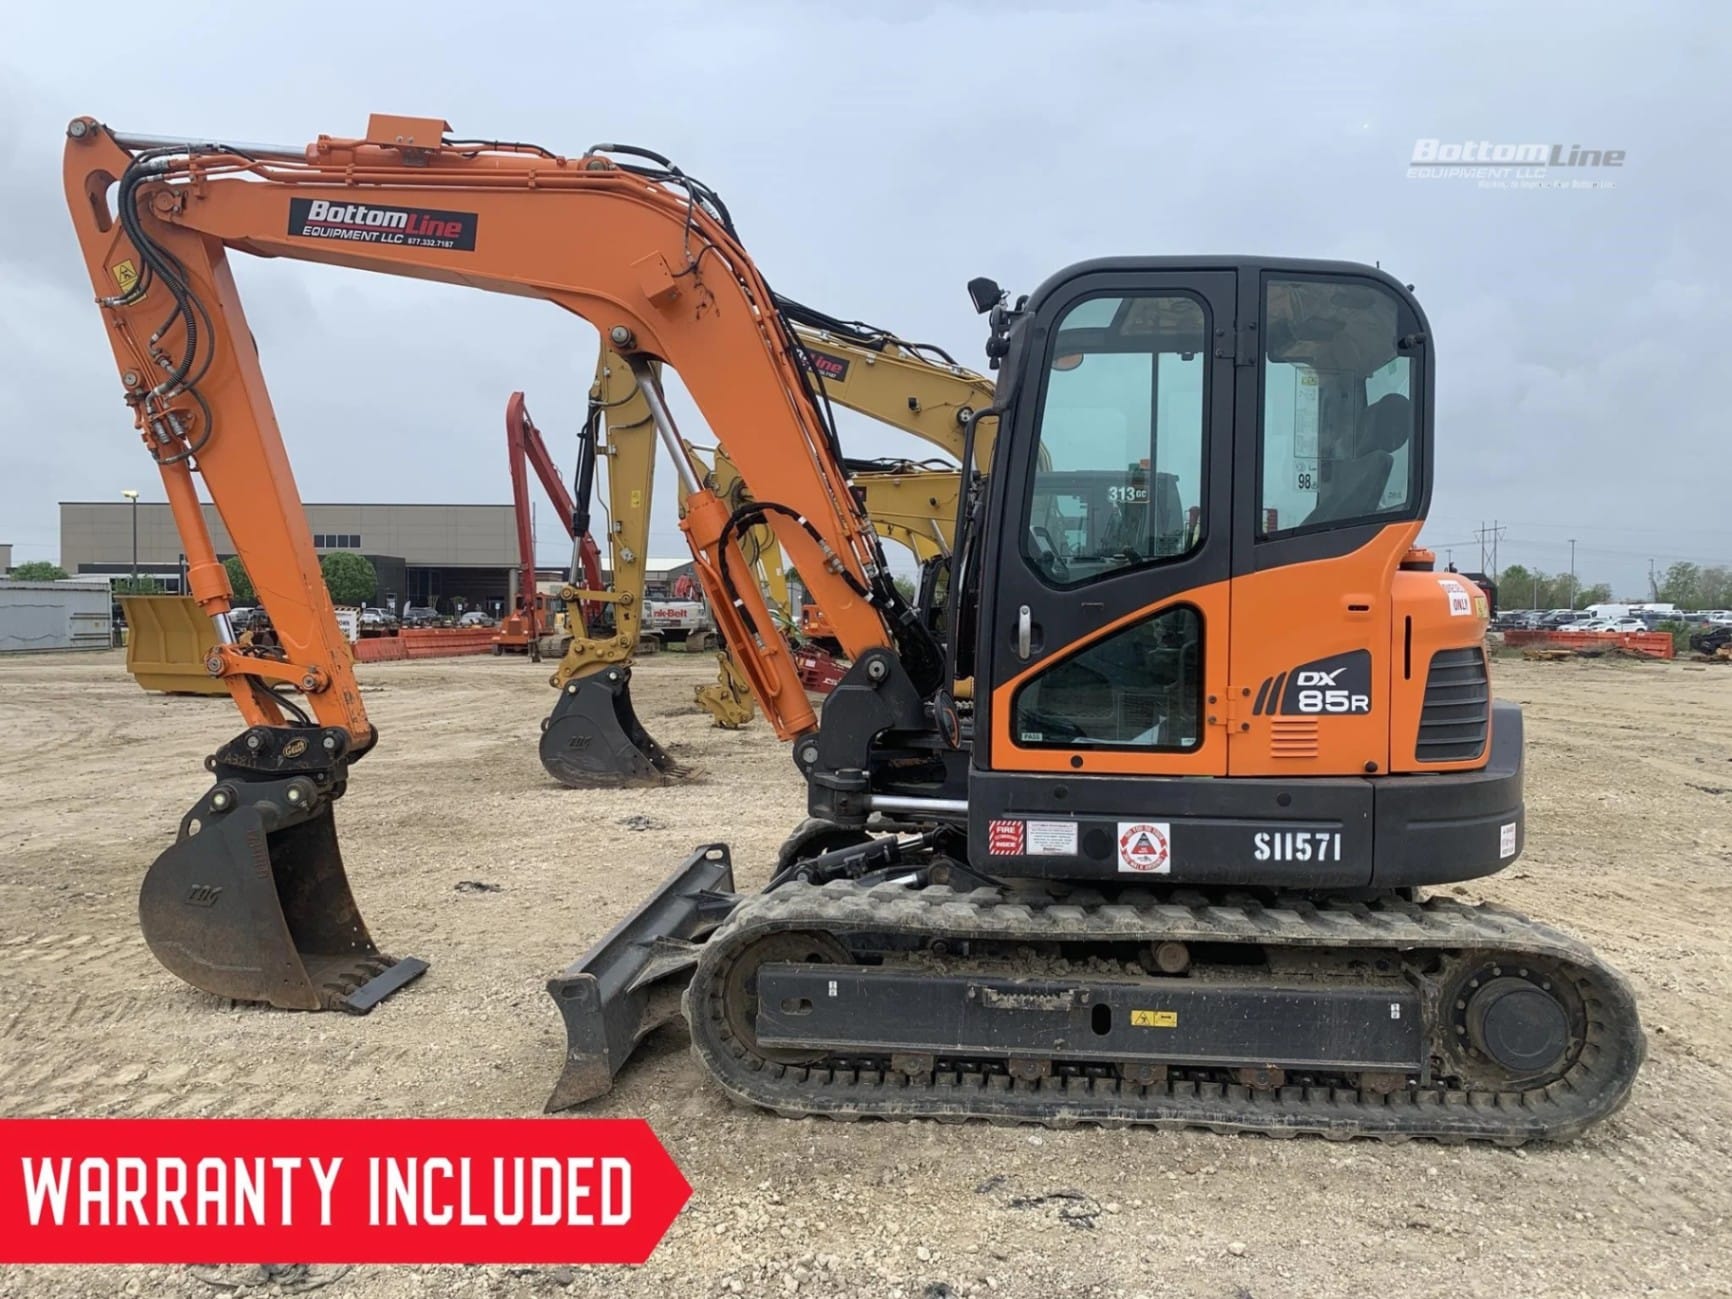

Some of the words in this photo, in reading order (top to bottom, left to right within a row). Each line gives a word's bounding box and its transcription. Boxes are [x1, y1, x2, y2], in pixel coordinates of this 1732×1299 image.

[302, 226, 379, 242] EQUIPMENT
[380, 233, 404, 244] LLC
[1298, 473, 1311, 489] 98
[1297, 668, 1347, 686] DX
[1298, 690, 1369, 712] 85R
[996, 826, 1016, 834] FIRE
